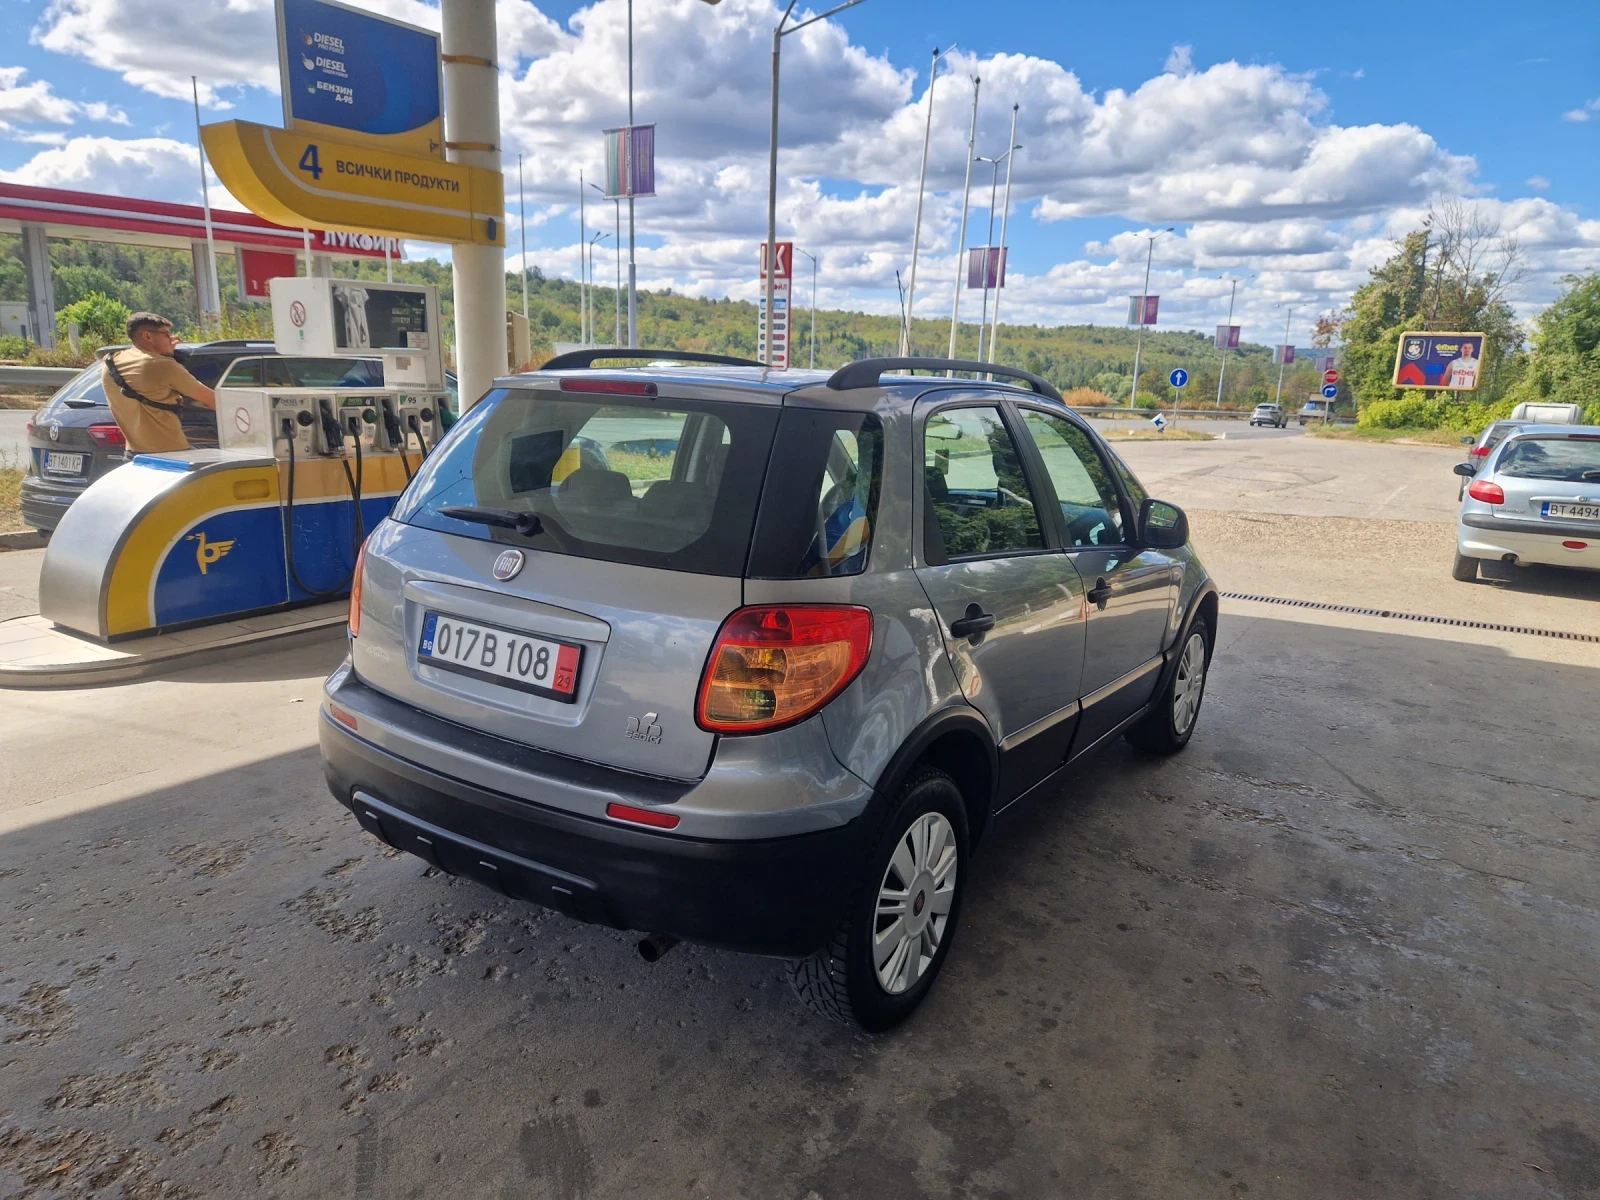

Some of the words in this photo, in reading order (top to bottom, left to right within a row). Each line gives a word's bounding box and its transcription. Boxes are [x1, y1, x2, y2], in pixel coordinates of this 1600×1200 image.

[314, 32, 344, 49] DIESEL
[316, 56, 346, 72] DIESEL
[317, 80, 353, 96] БЕНЗИН
[298, 144, 323, 180] 4
[336, 160, 392, 182] ВСИЧКИ
[395, 170, 460, 193] ПРОДУКТИ
[58, 455, 71, 470] 1401
[72, 457, 82, 470] KP
[1550, 504, 1567, 515] BT
[1569, 506, 1599, 518] 4494
[497, 556, 518, 573] FIAT
[422, 639, 433, 650] BG
[556, 674, 571, 688] 29
